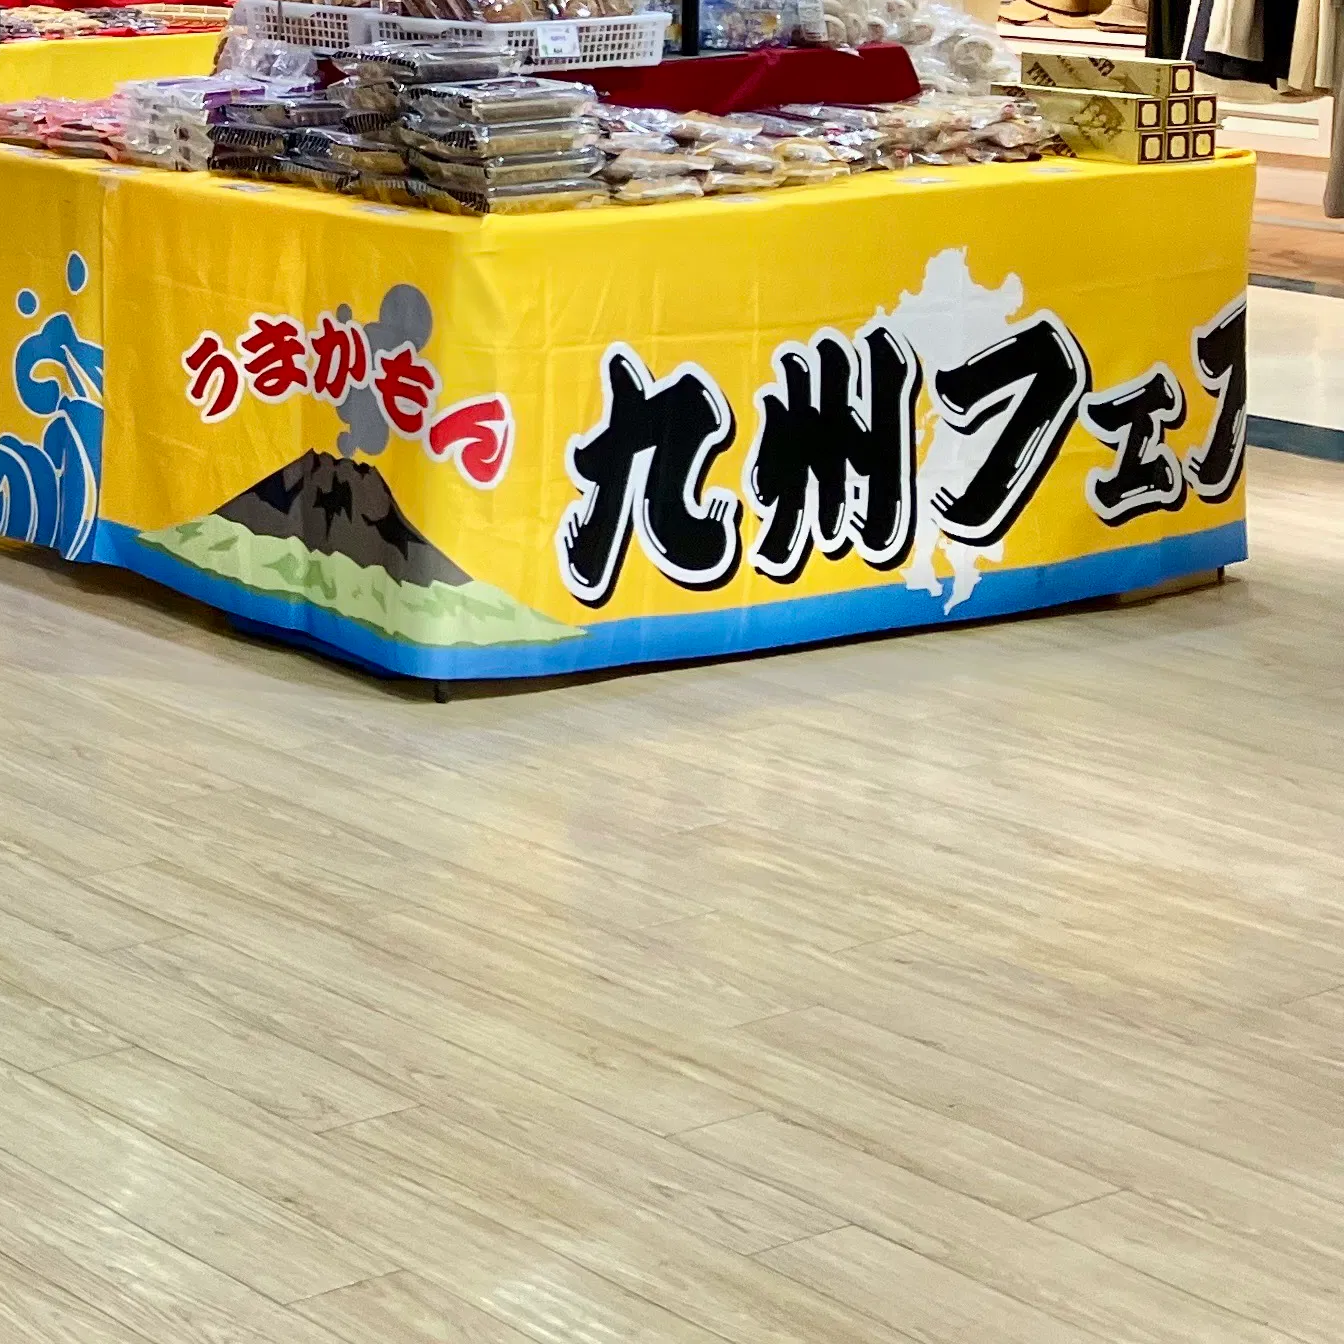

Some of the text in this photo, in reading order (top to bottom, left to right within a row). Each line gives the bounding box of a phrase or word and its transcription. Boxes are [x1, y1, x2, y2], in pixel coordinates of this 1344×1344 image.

[181, 311, 513, 492] うまかもん
